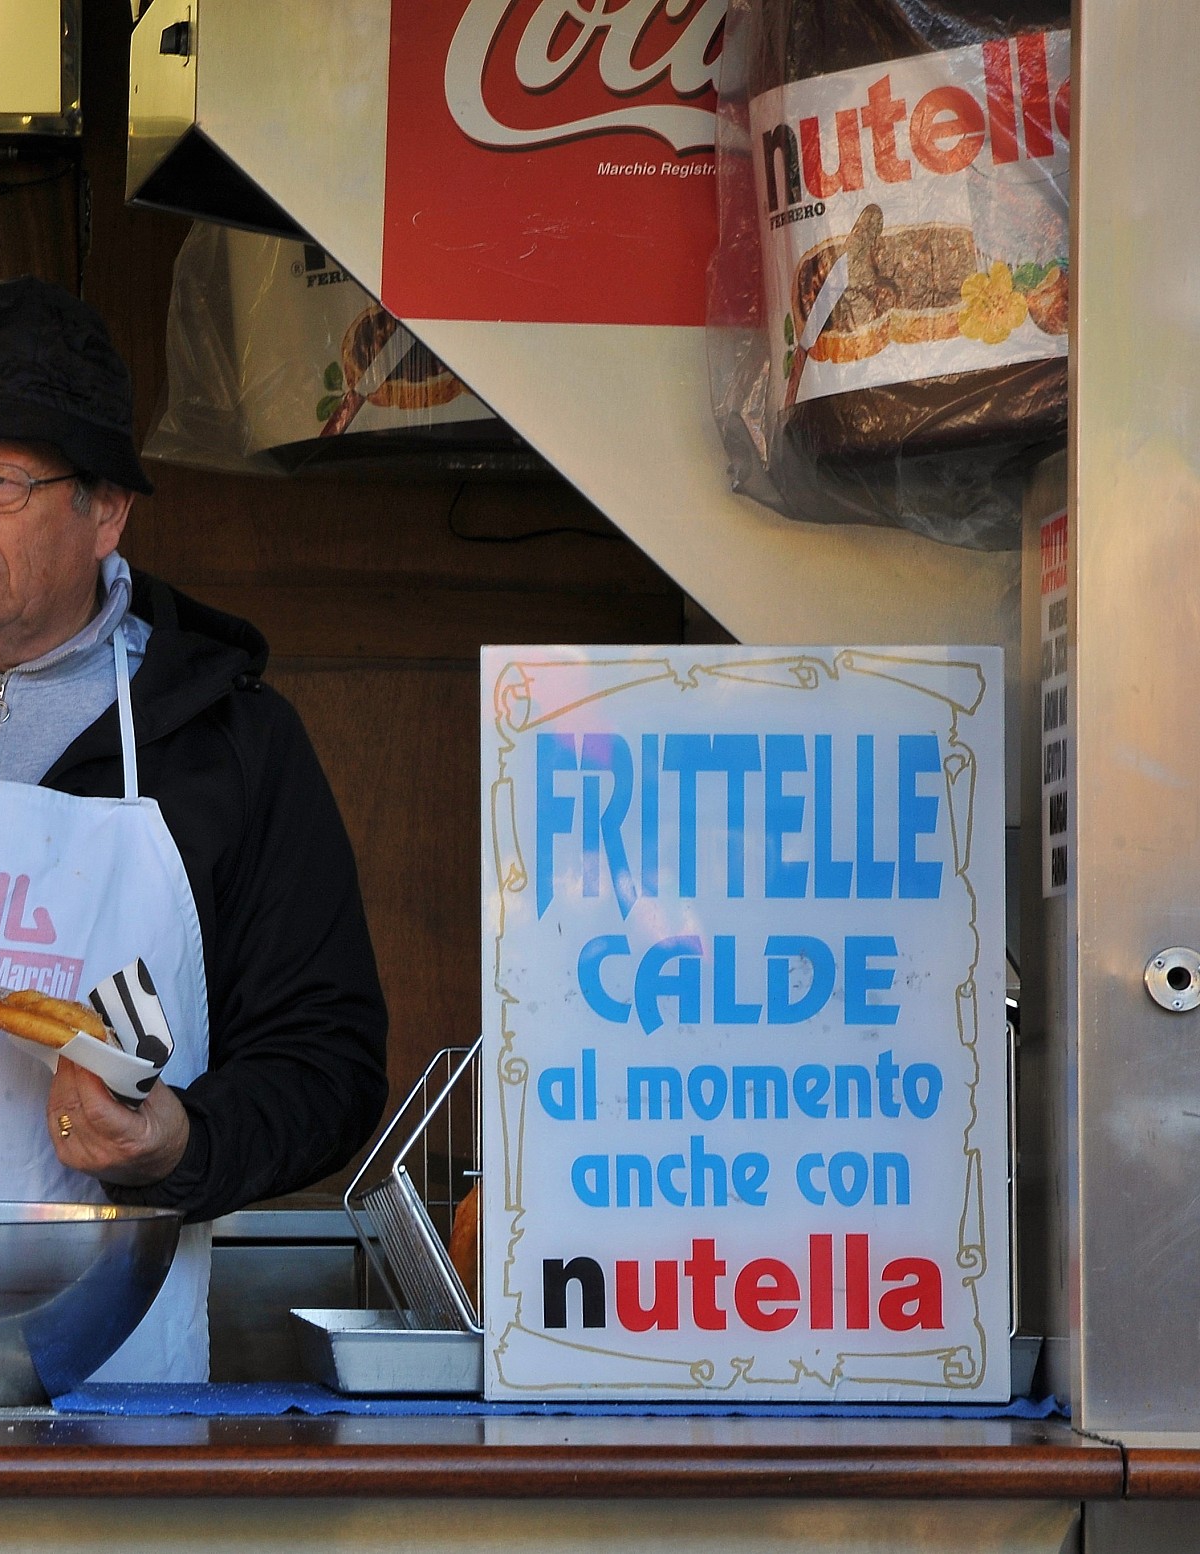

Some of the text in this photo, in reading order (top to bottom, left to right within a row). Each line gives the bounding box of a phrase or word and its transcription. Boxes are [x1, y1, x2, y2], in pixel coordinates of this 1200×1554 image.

[761, 31, 1071, 213] nutell
[597, 162, 656, 175] Marchio
[769, 202, 826, 231] FERRERO
[535, 733, 943, 921] FRITTELLE
[577, 934, 901, 1036] CALDE
[537, 1048, 944, 1122] al momento
[571, 1135, 911, 1208] anche con
[542, 1234, 944, 1332] nutella
